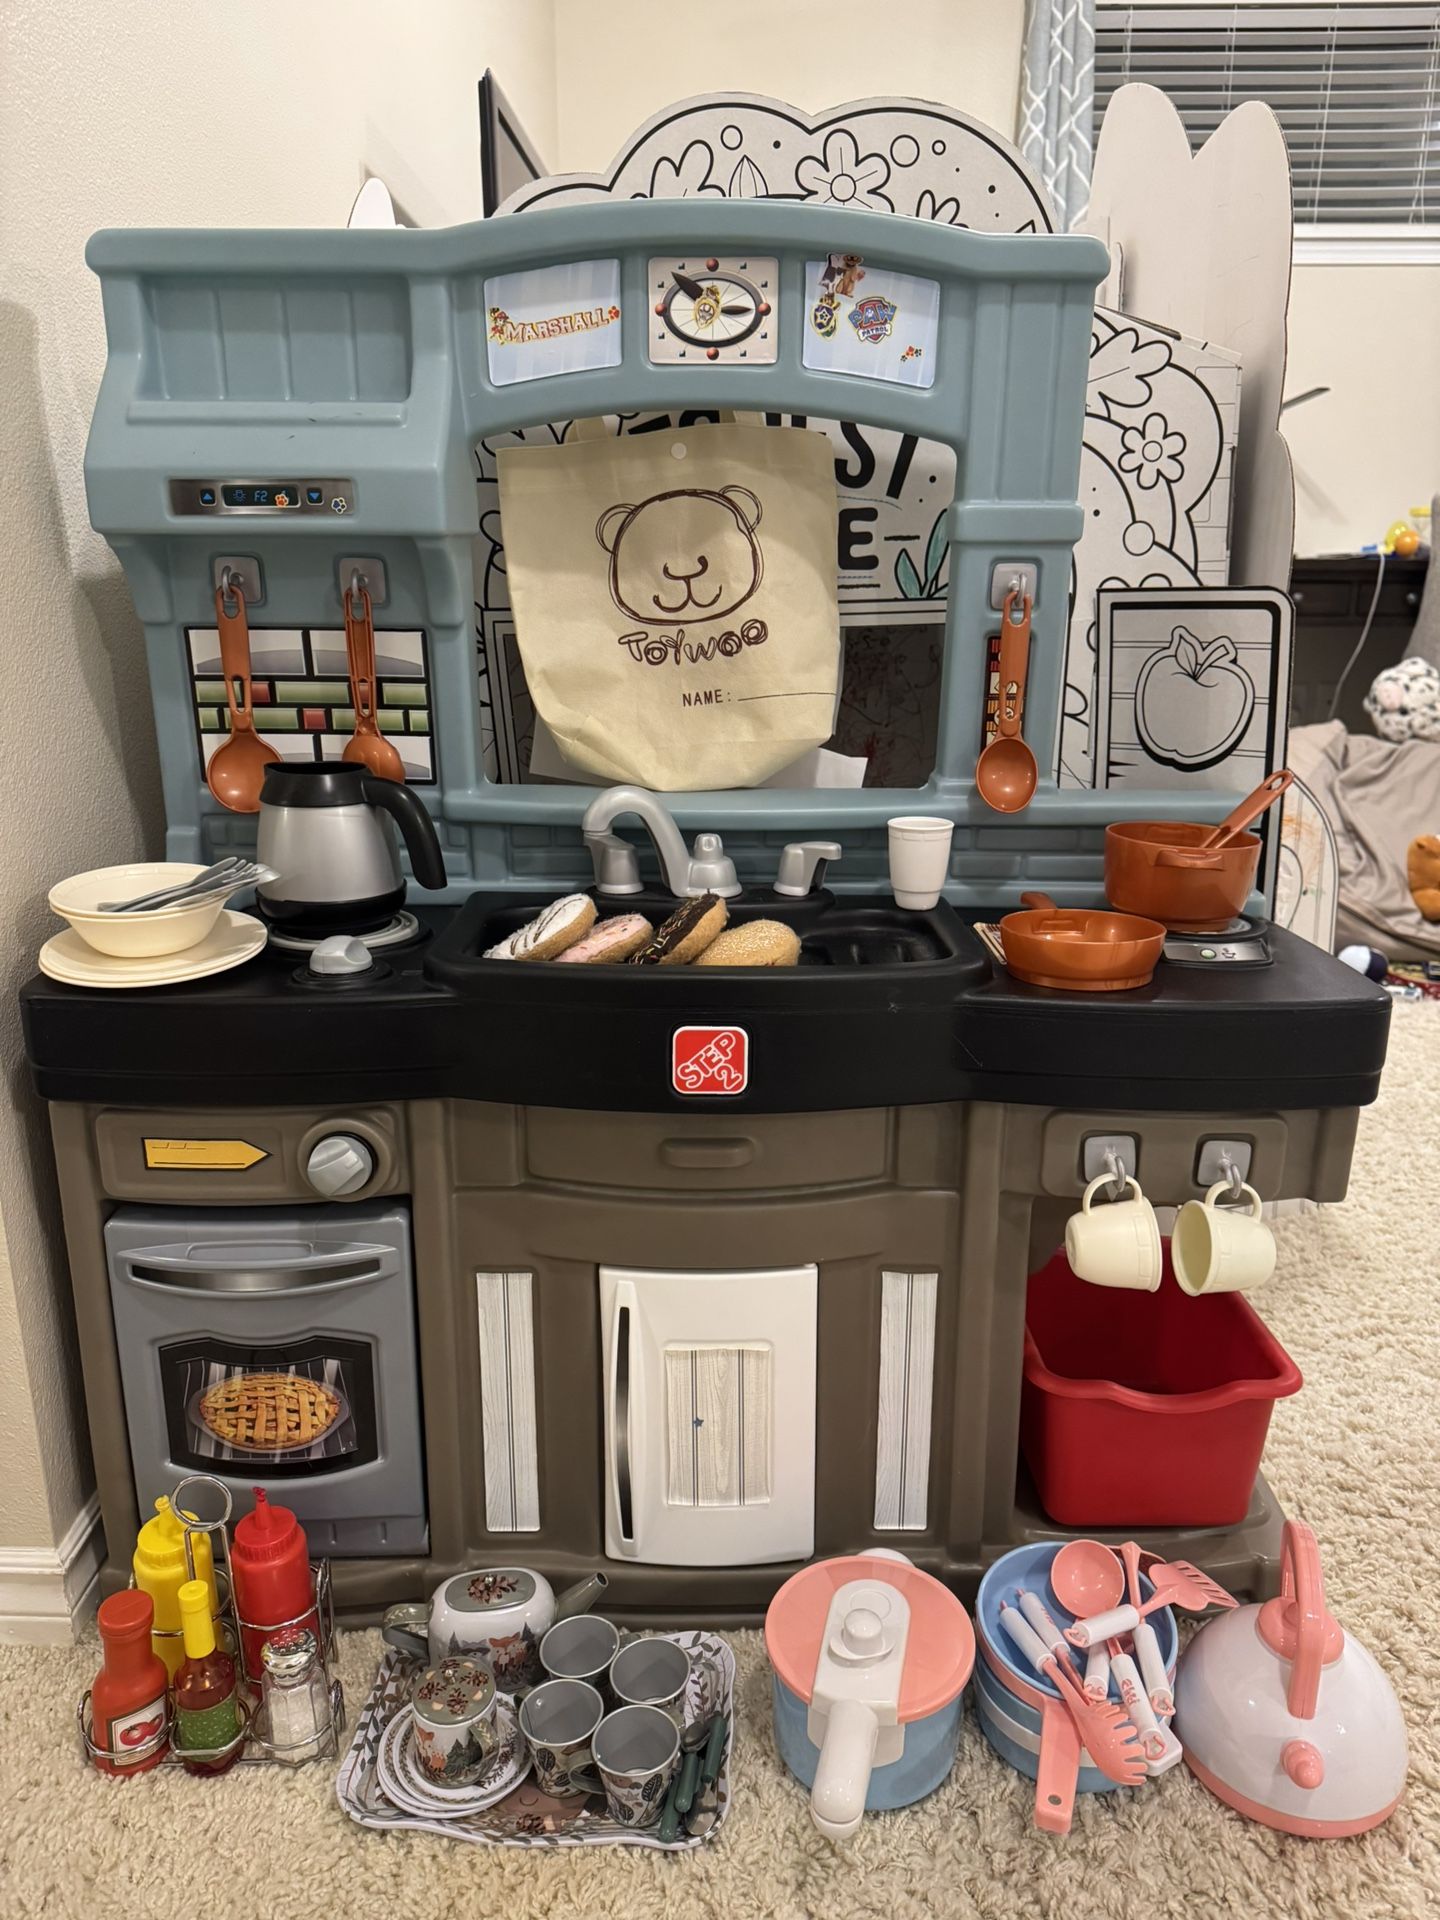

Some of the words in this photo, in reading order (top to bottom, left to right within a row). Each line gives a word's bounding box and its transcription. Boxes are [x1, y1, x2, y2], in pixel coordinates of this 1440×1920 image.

[503, 308, 609, 342] MARSHALL
[848, 304, 897, 329] PAW
[861, 326, 889, 337] PATROL
[254, 490, 268, 502] F2
[682, 689, 731, 707] NAME:
[677, 1032, 736, 1089] STEP
[714, 1063, 743, 1090] 2
